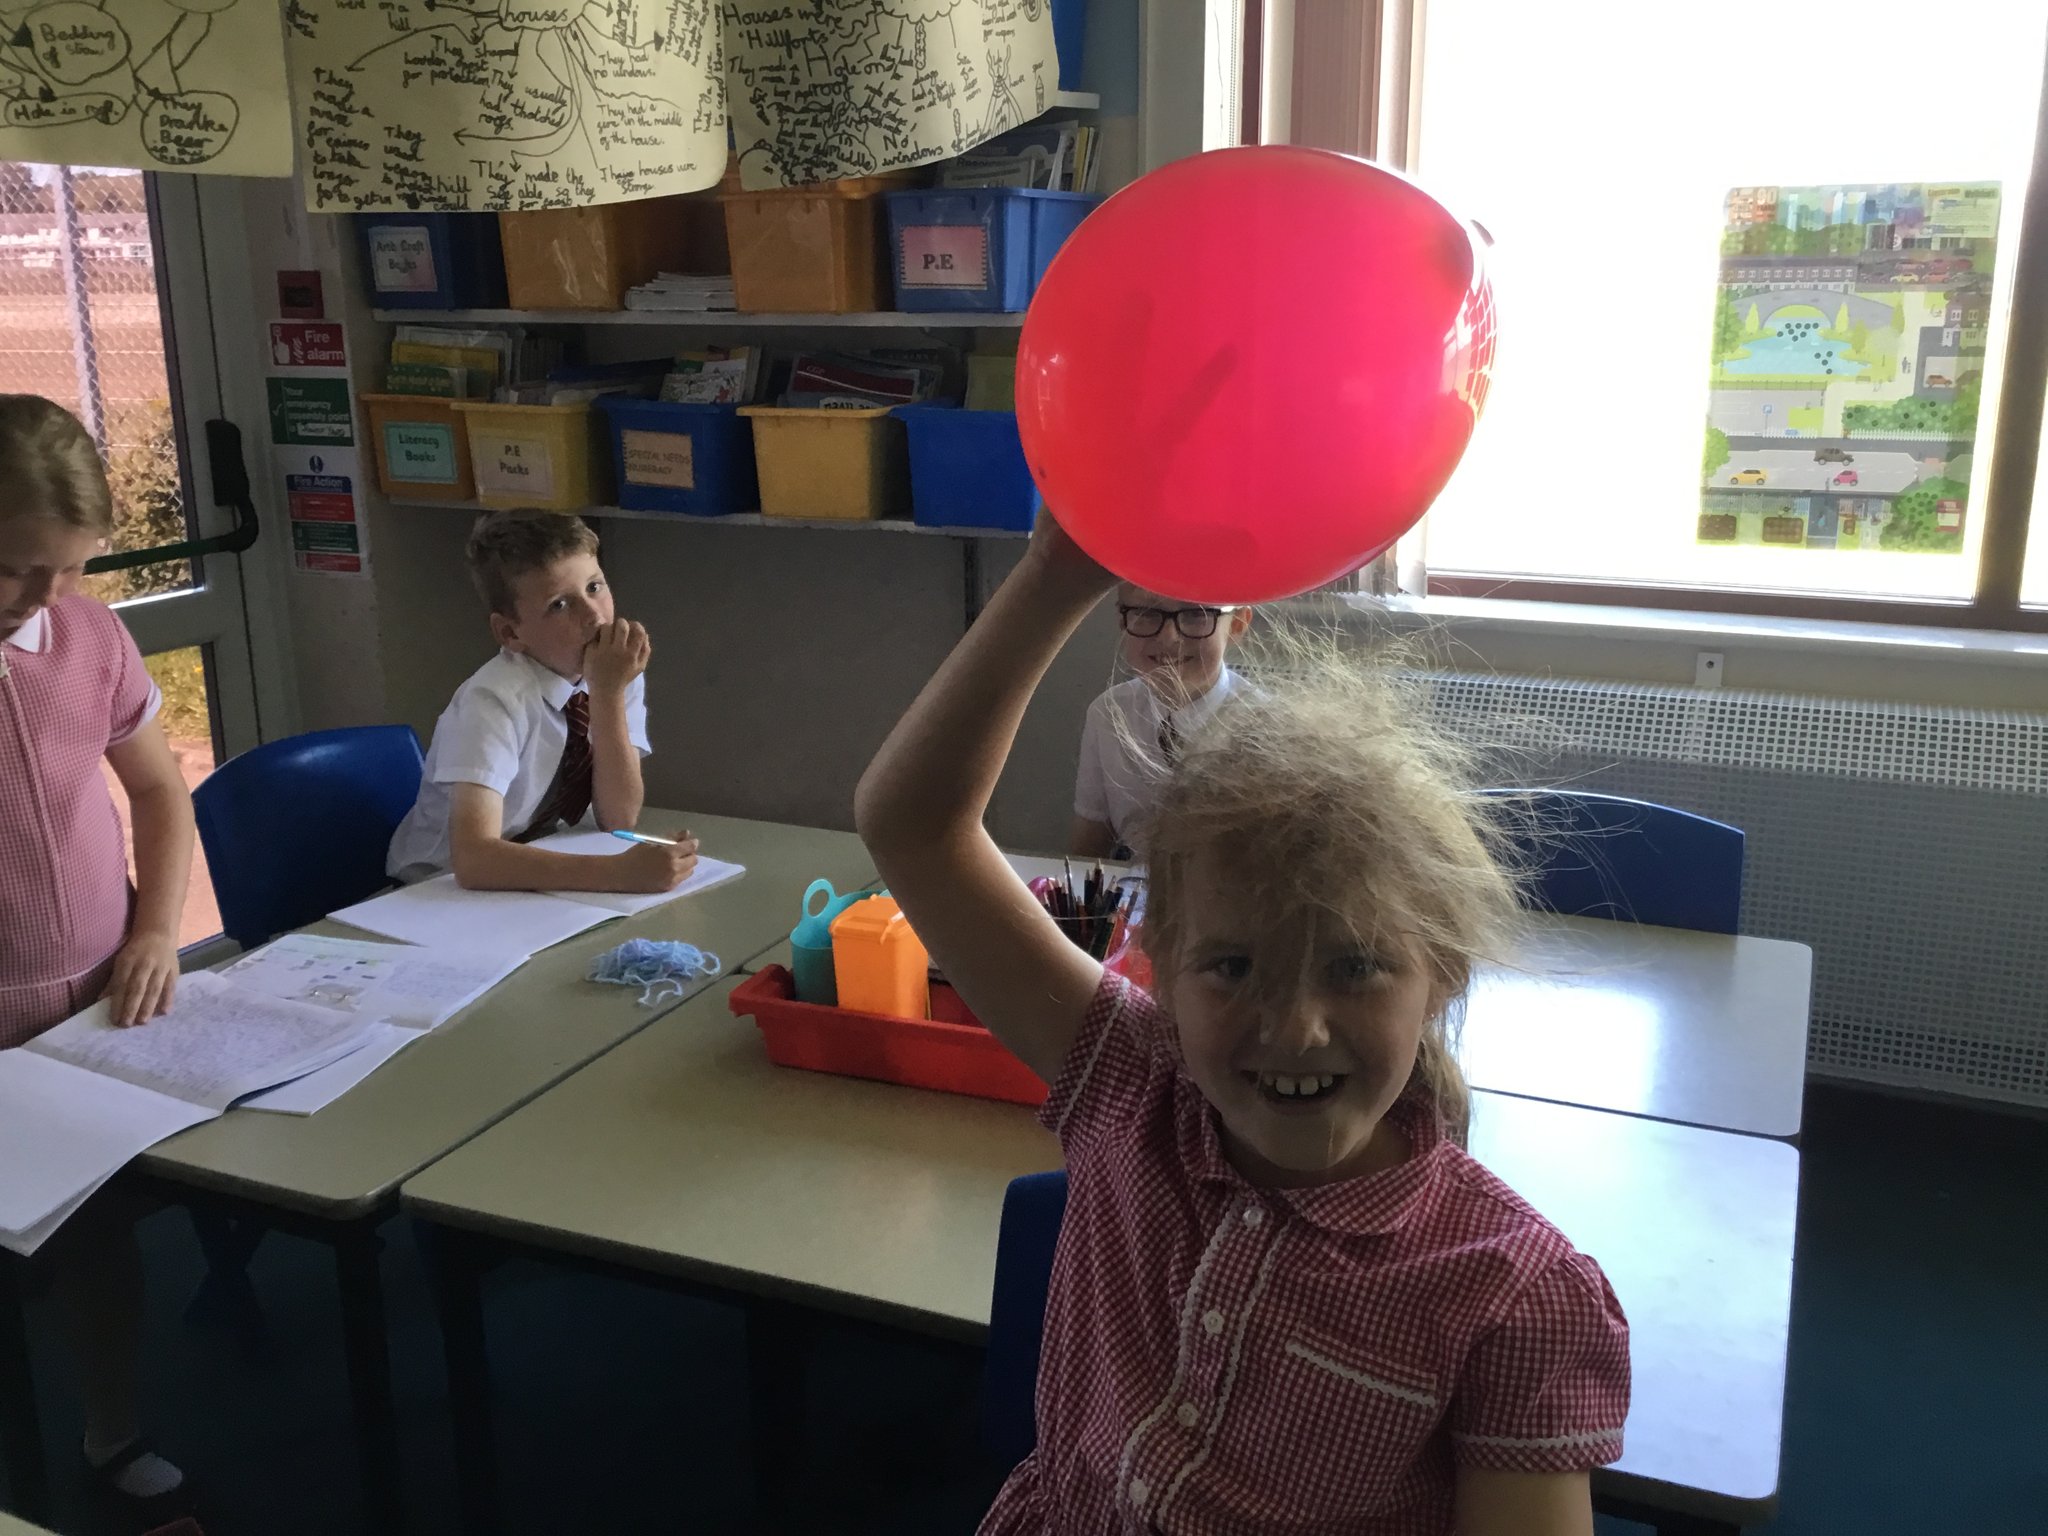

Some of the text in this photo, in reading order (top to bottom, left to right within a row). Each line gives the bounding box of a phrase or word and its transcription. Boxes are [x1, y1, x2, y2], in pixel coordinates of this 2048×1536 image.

[504, 0, 568, 23] houses
[722, 3, 794, 26] Houses
[40, 23, 115, 50] Bedding
[598, 50, 625, 71] They
[525, 86, 567, 115] usually
[883, 134, 909, 151] No
[882, 140, 944, 166] windows
[525, 161, 559, 183] made
[639, 160, 674, 177] houses
[437, 175, 472, 194] hill
[923, 254, 953, 270] P.E
[304, 330, 330, 343] Fire
[306, 347, 345, 361] alarm
[398, 433, 439, 449] Literacy
[404, 450, 436, 463] Books
[504, 445, 521, 458] P.E
[662, 452, 691, 465] NEEDS
[499, 459, 529, 475] Packs
[314, 476, 343, 489] Action
